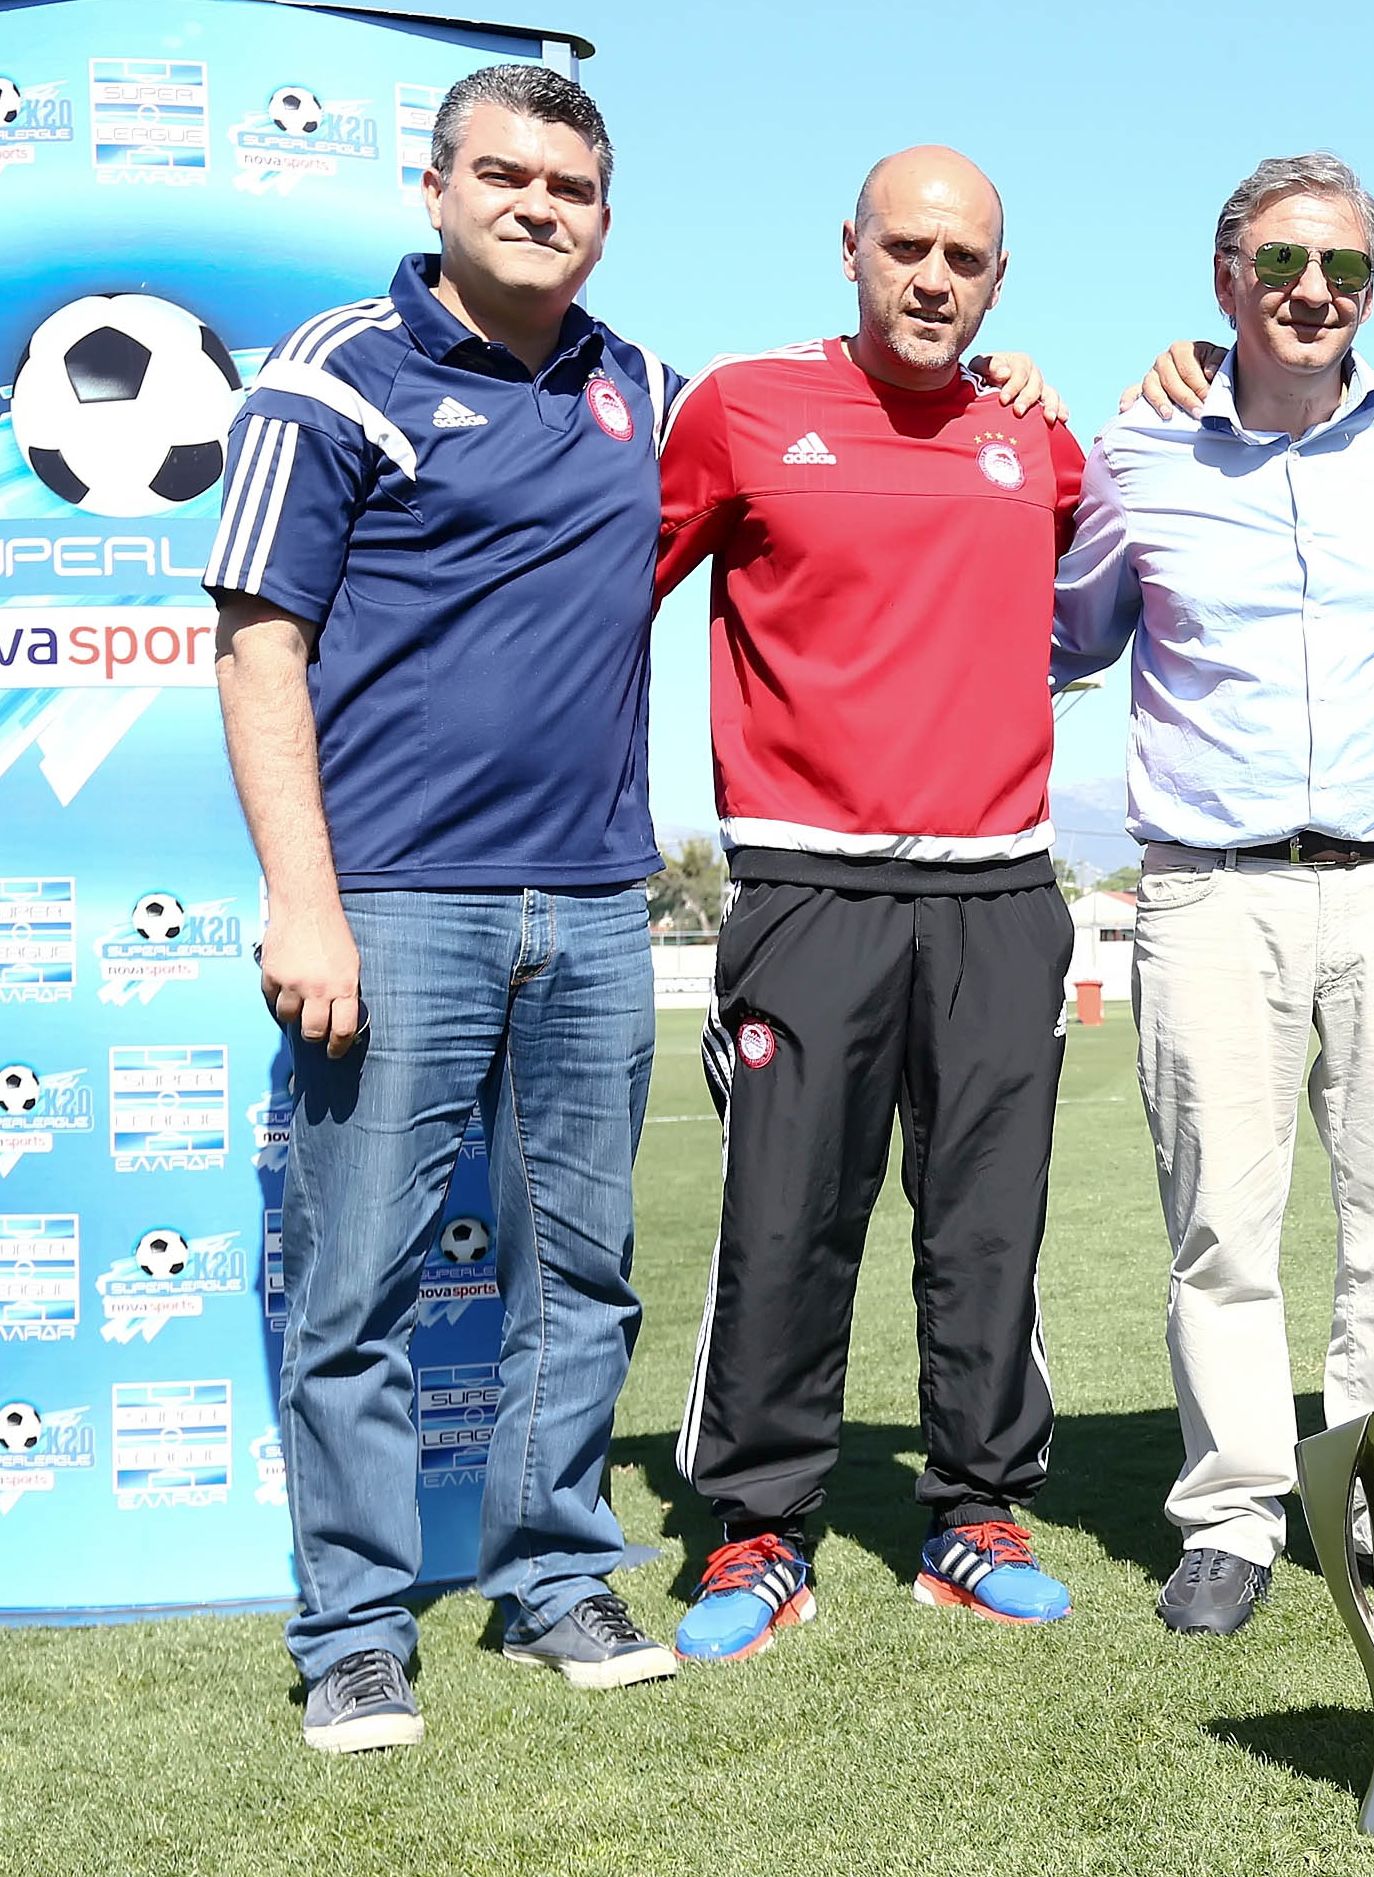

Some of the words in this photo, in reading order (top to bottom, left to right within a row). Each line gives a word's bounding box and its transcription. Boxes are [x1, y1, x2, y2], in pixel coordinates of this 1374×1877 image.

[104, 86, 193, 101] SUPER
[25, 98, 72, 127] K20
[97, 127, 204, 143] LEAGUE
[328, 113, 378, 146] K20
[243, 135, 377, 157] SUPERLEAGUE
[433, 415, 489, 428] adidas
[783, 452, 837, 465] adidas
[189, 916, 240, 944] K20
[107, 944, 237, 957] SUPERLEAGUE
[44, 1088, 91, 1115] K20
[192, 1251, 243, 1279] K20
[111, 1280, 241, 1294] SUPERLEAGUE
[46, 1426, 93, 1454] K20
[423, 1428, 495, 1446] LEAG
